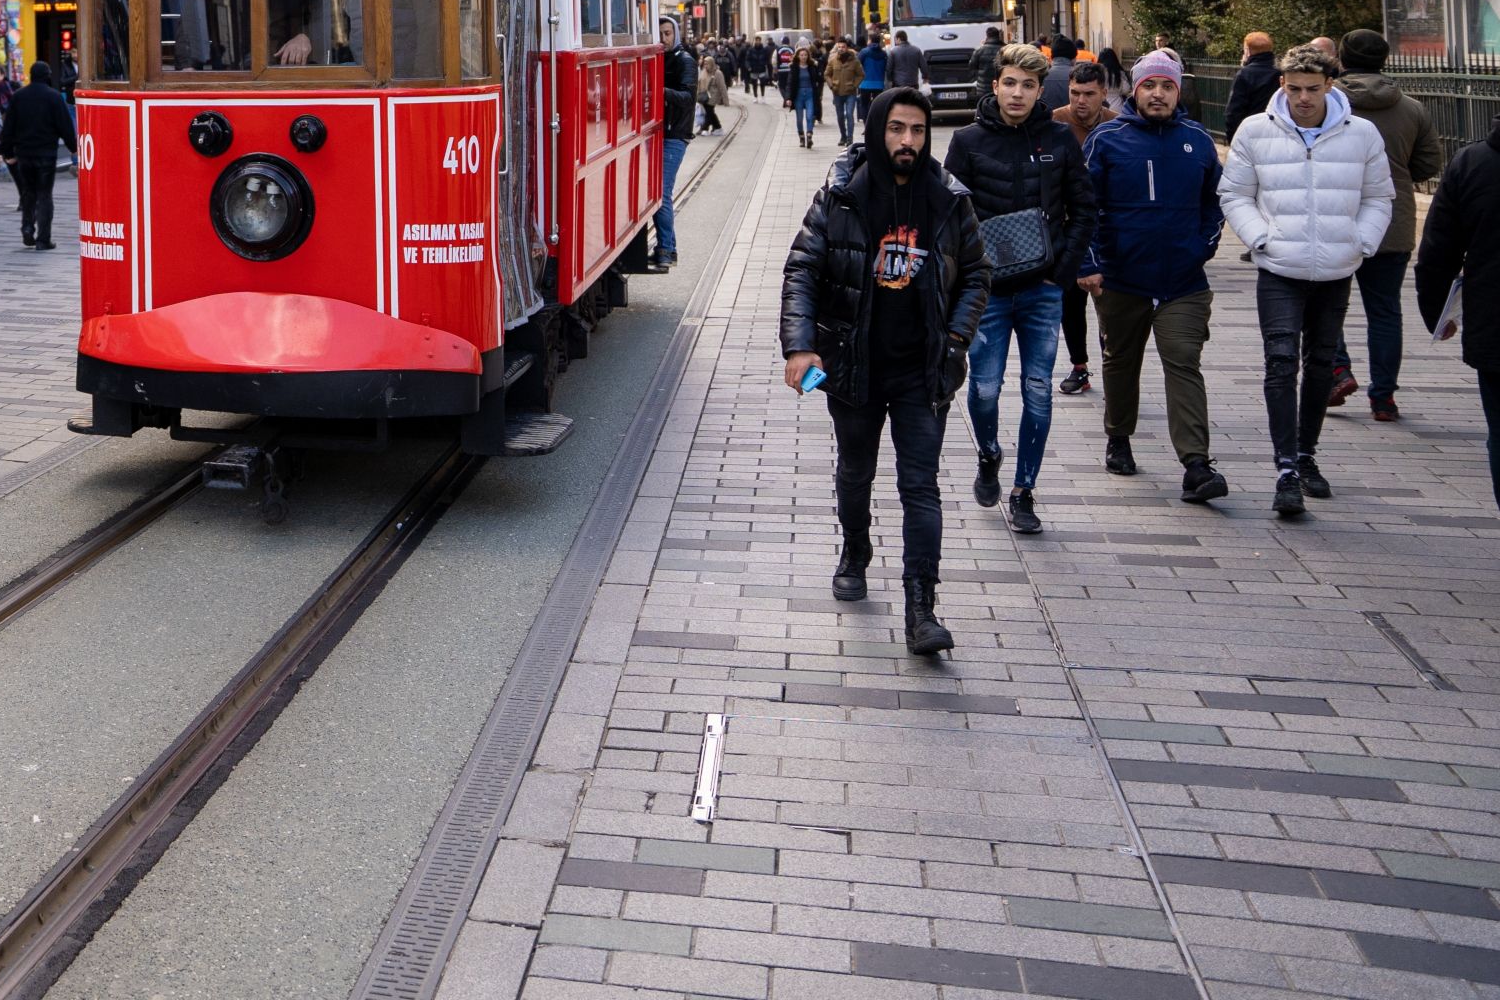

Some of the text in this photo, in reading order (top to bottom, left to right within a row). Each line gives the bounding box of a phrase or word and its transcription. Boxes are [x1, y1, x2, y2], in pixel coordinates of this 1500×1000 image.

[443, 135, 480, 174] 410
[94, 221, 124, 239] YASAK
[403, 222, 484, 240] ASILMAK YASAK
[404, 243, 483, 263] VE TEHLİKELİDİR
